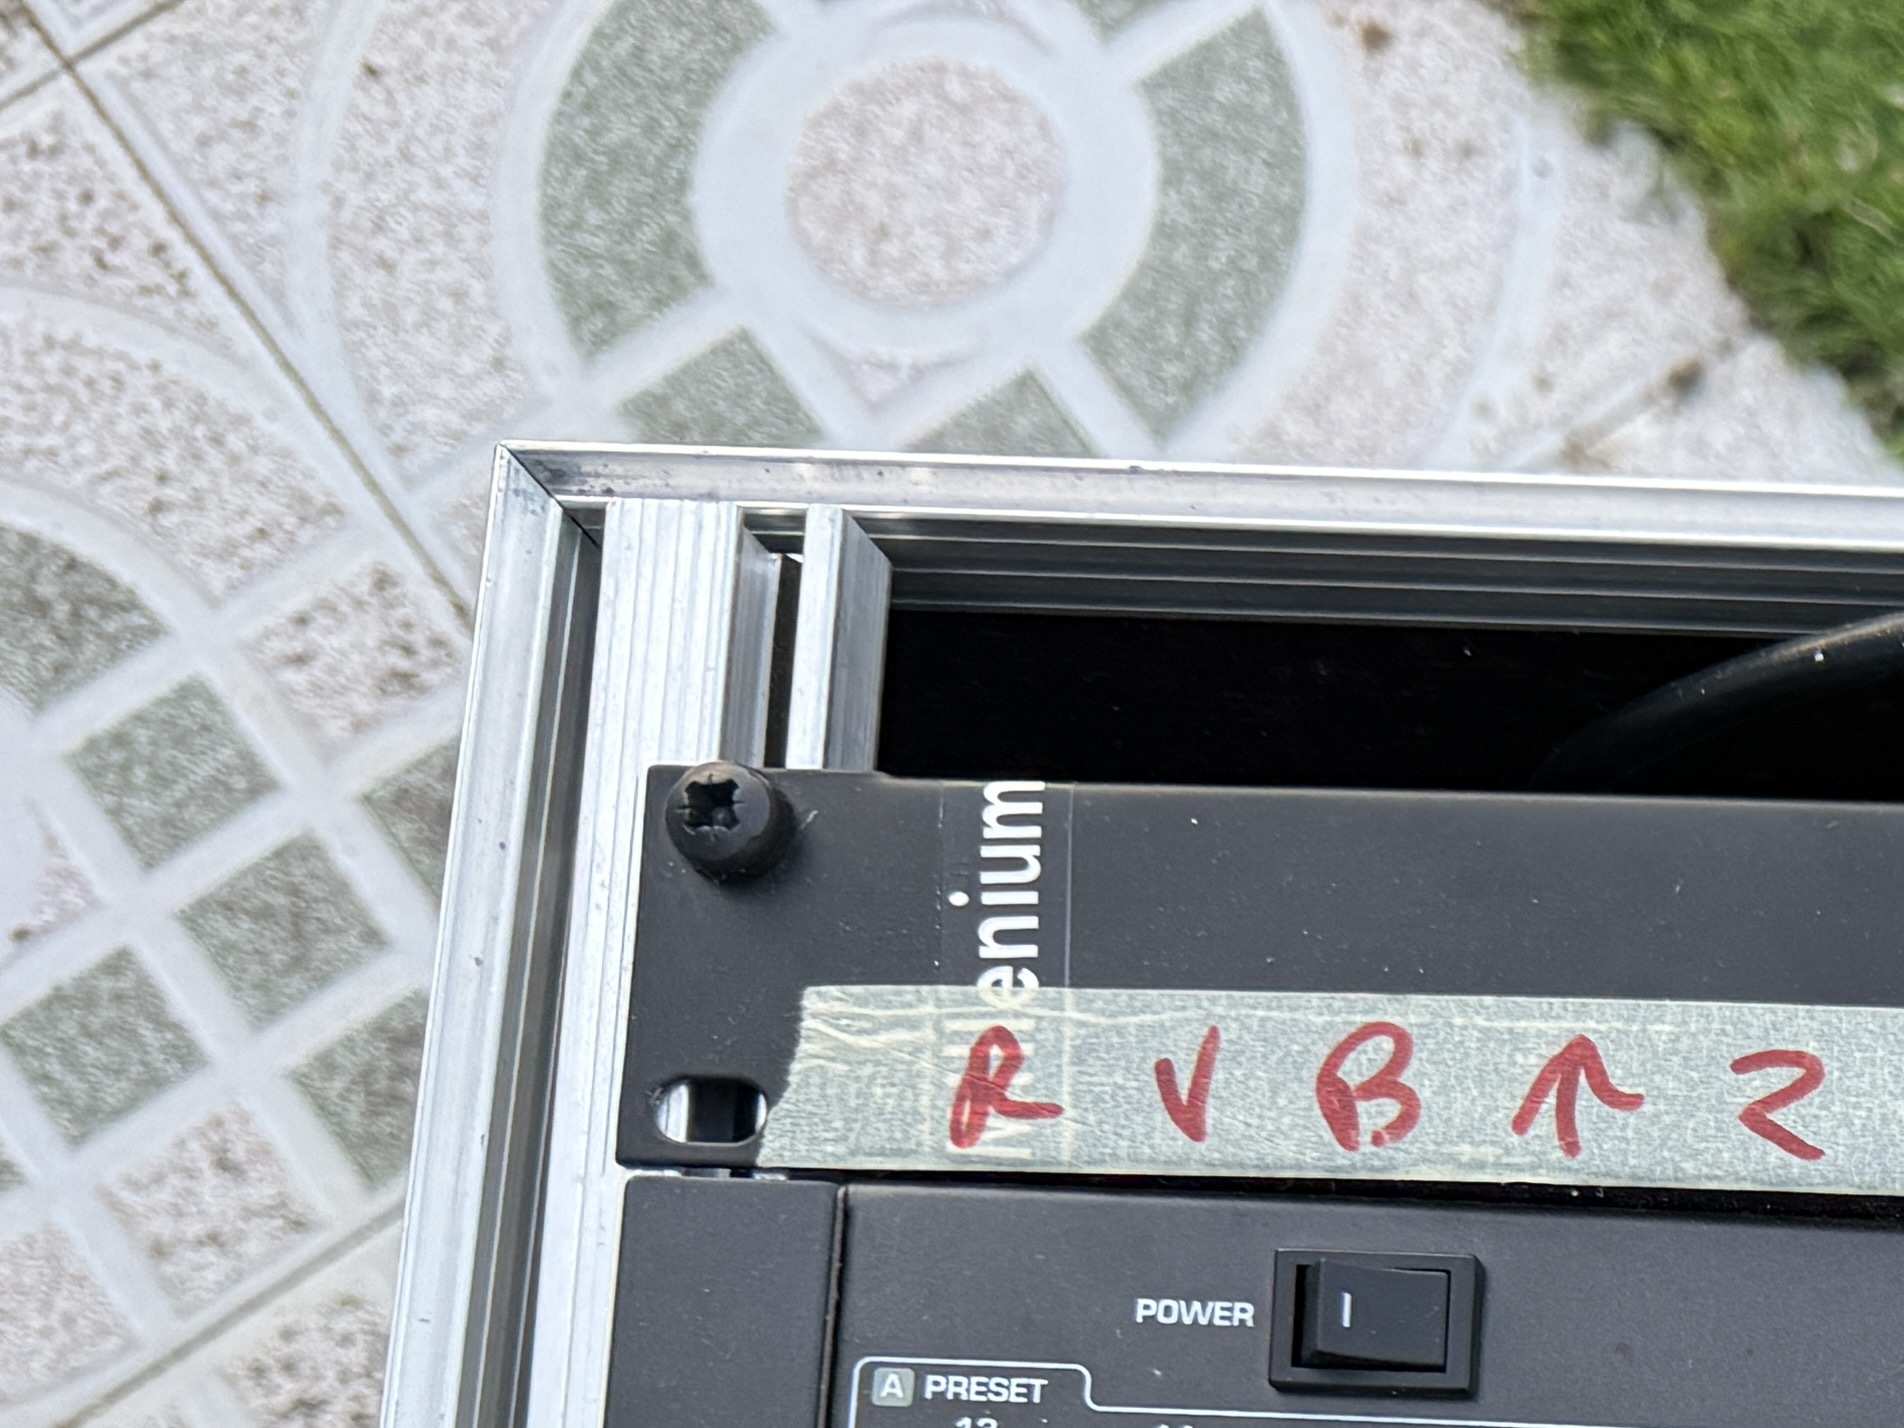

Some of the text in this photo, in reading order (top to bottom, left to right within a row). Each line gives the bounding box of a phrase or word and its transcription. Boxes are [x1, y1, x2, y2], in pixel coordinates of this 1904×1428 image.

[948, 1026, 1063, 1149] R
[1316, 1021, 1421, 1150] B
[1136, 1298, 1254, 1327] POWER
[880, 1373, 1048, 1403] A PRESET
